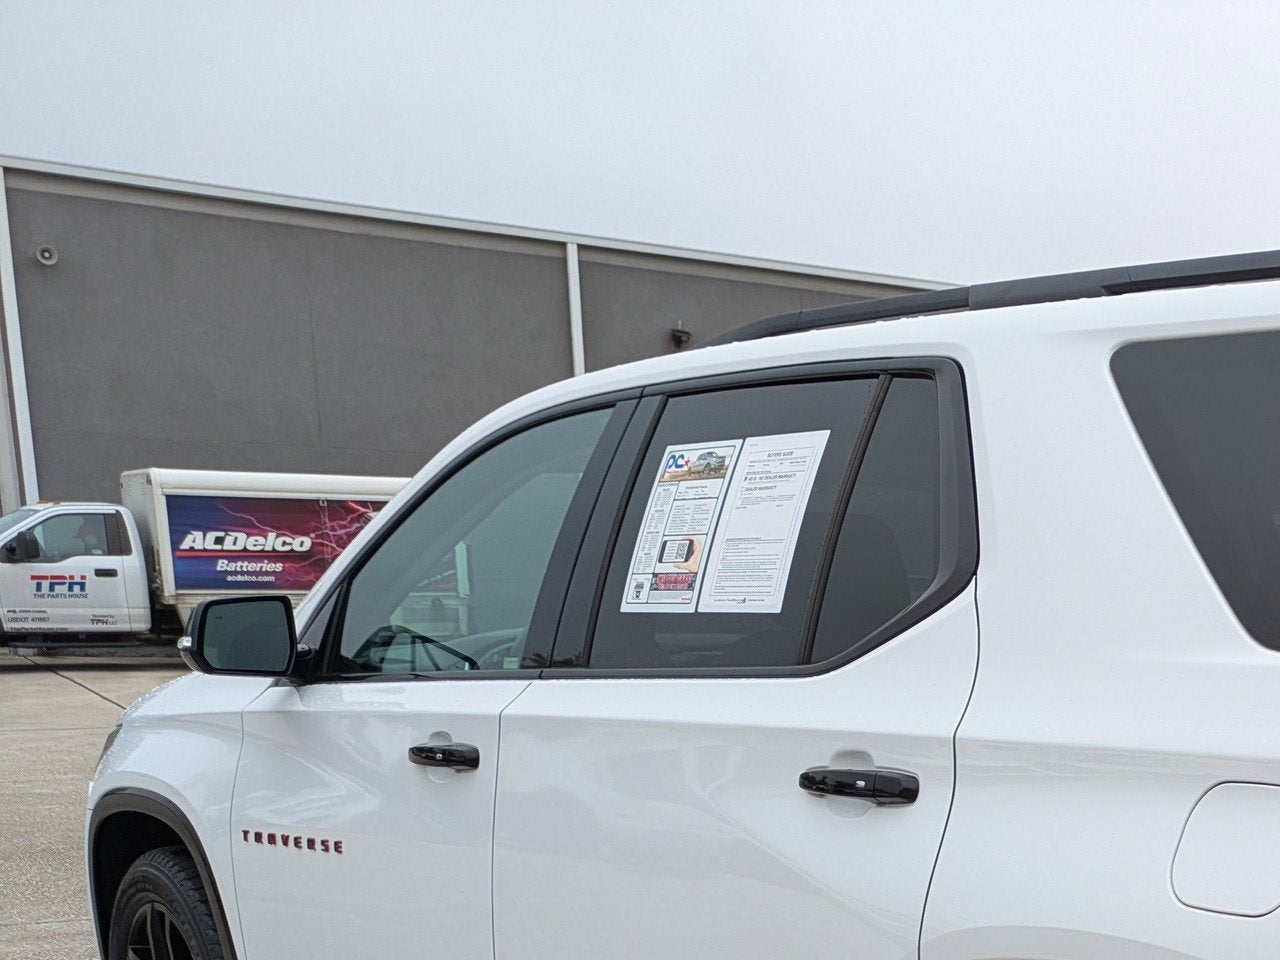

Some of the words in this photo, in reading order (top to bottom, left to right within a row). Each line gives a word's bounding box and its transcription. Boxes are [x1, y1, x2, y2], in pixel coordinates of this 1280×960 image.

[179, 531, 312, 552] ACDelco
[216, 559, 284, 572] Batteries
[30, 575, 87, 592] TPH
[226, 574, 276, 582] acdelco.com
[241, 829, 343, 855] TRAVERSE
